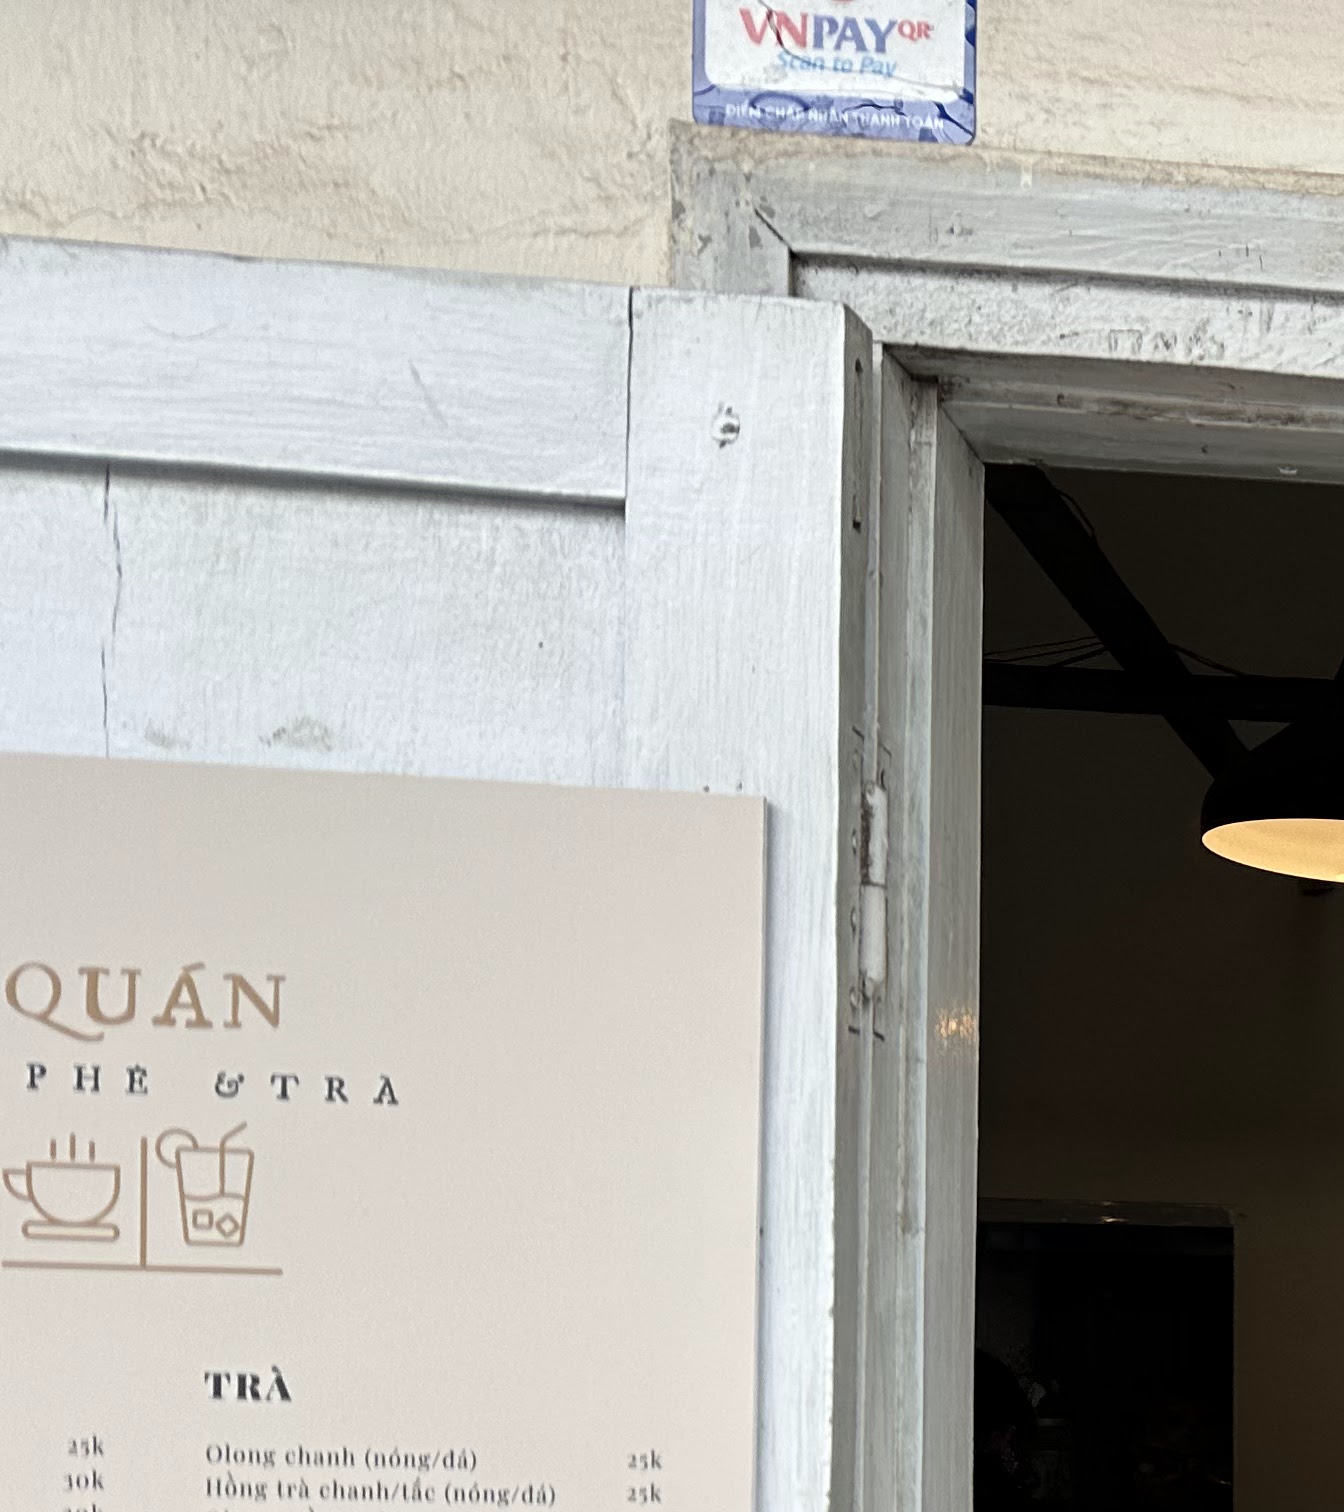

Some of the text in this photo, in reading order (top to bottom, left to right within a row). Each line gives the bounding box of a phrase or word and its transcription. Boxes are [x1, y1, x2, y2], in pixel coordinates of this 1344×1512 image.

[777, 51, 897, 78] Scan to Pay
[5, 960, 286, 1042] QUÁN
[204, 1366, 292, 1401] TRÀ
[68, 1433, 104, 1457] 25k
[205, 1442, 276, 1469] Olong
[285, 1443, 355, 1468] chanh
[627, 1448, 663, 1471] 25k
[63, 1469, 104, 1492] 30k
[205, 1470, 268, 1501] Hồng
[277, 1477, 309, 1499] trà
[626, 1481, 662, 1504] 25k
